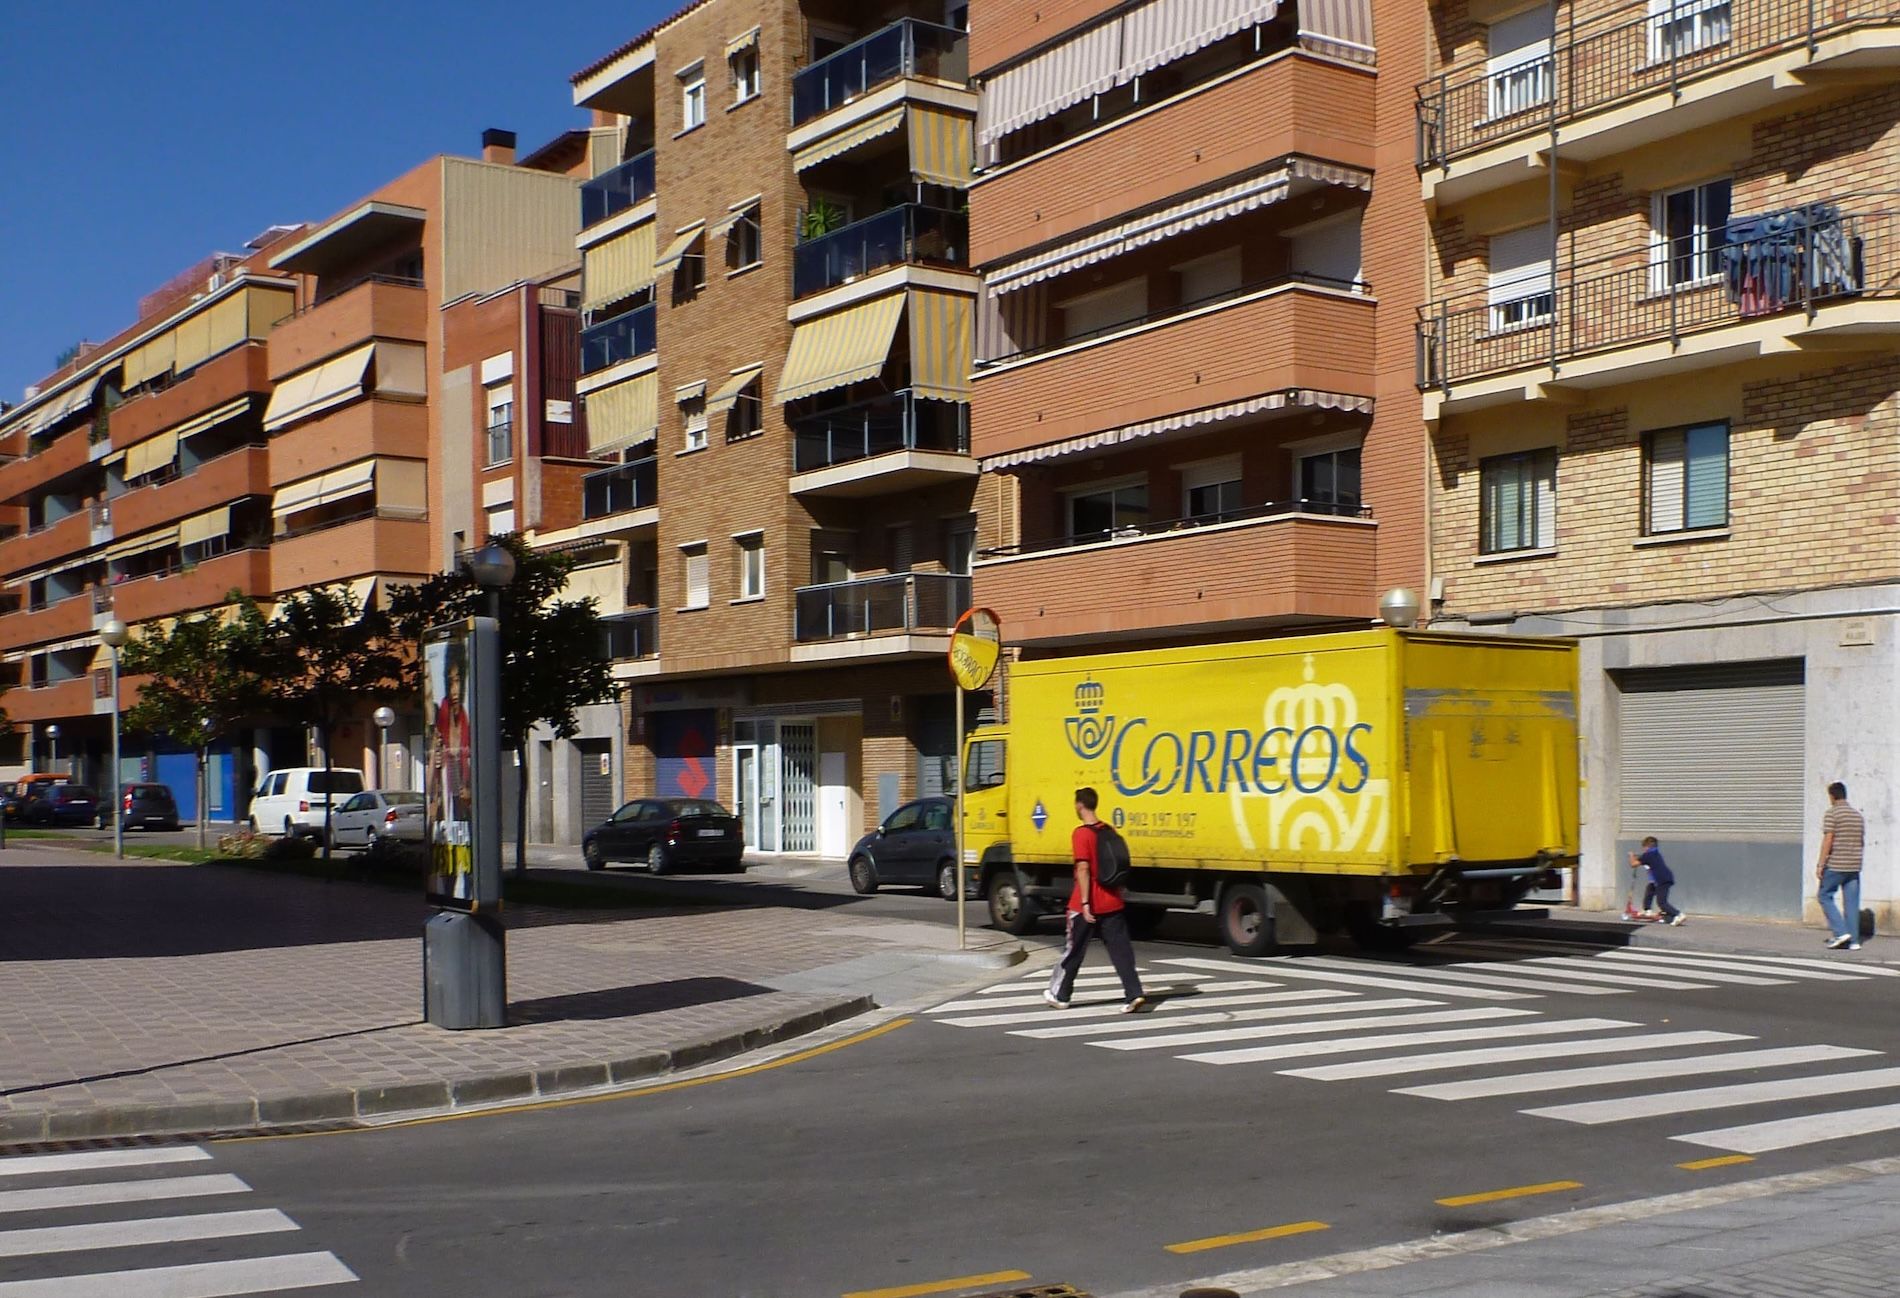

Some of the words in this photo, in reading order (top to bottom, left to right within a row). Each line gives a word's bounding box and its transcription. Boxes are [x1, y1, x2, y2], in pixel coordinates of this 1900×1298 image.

[1111, 722, 1373, 797] CORREOS
[1128, 811, 1148, 827] 902
[1151, 812, 1172, 827] 197
[1175, 812, 1197, 827] 197
